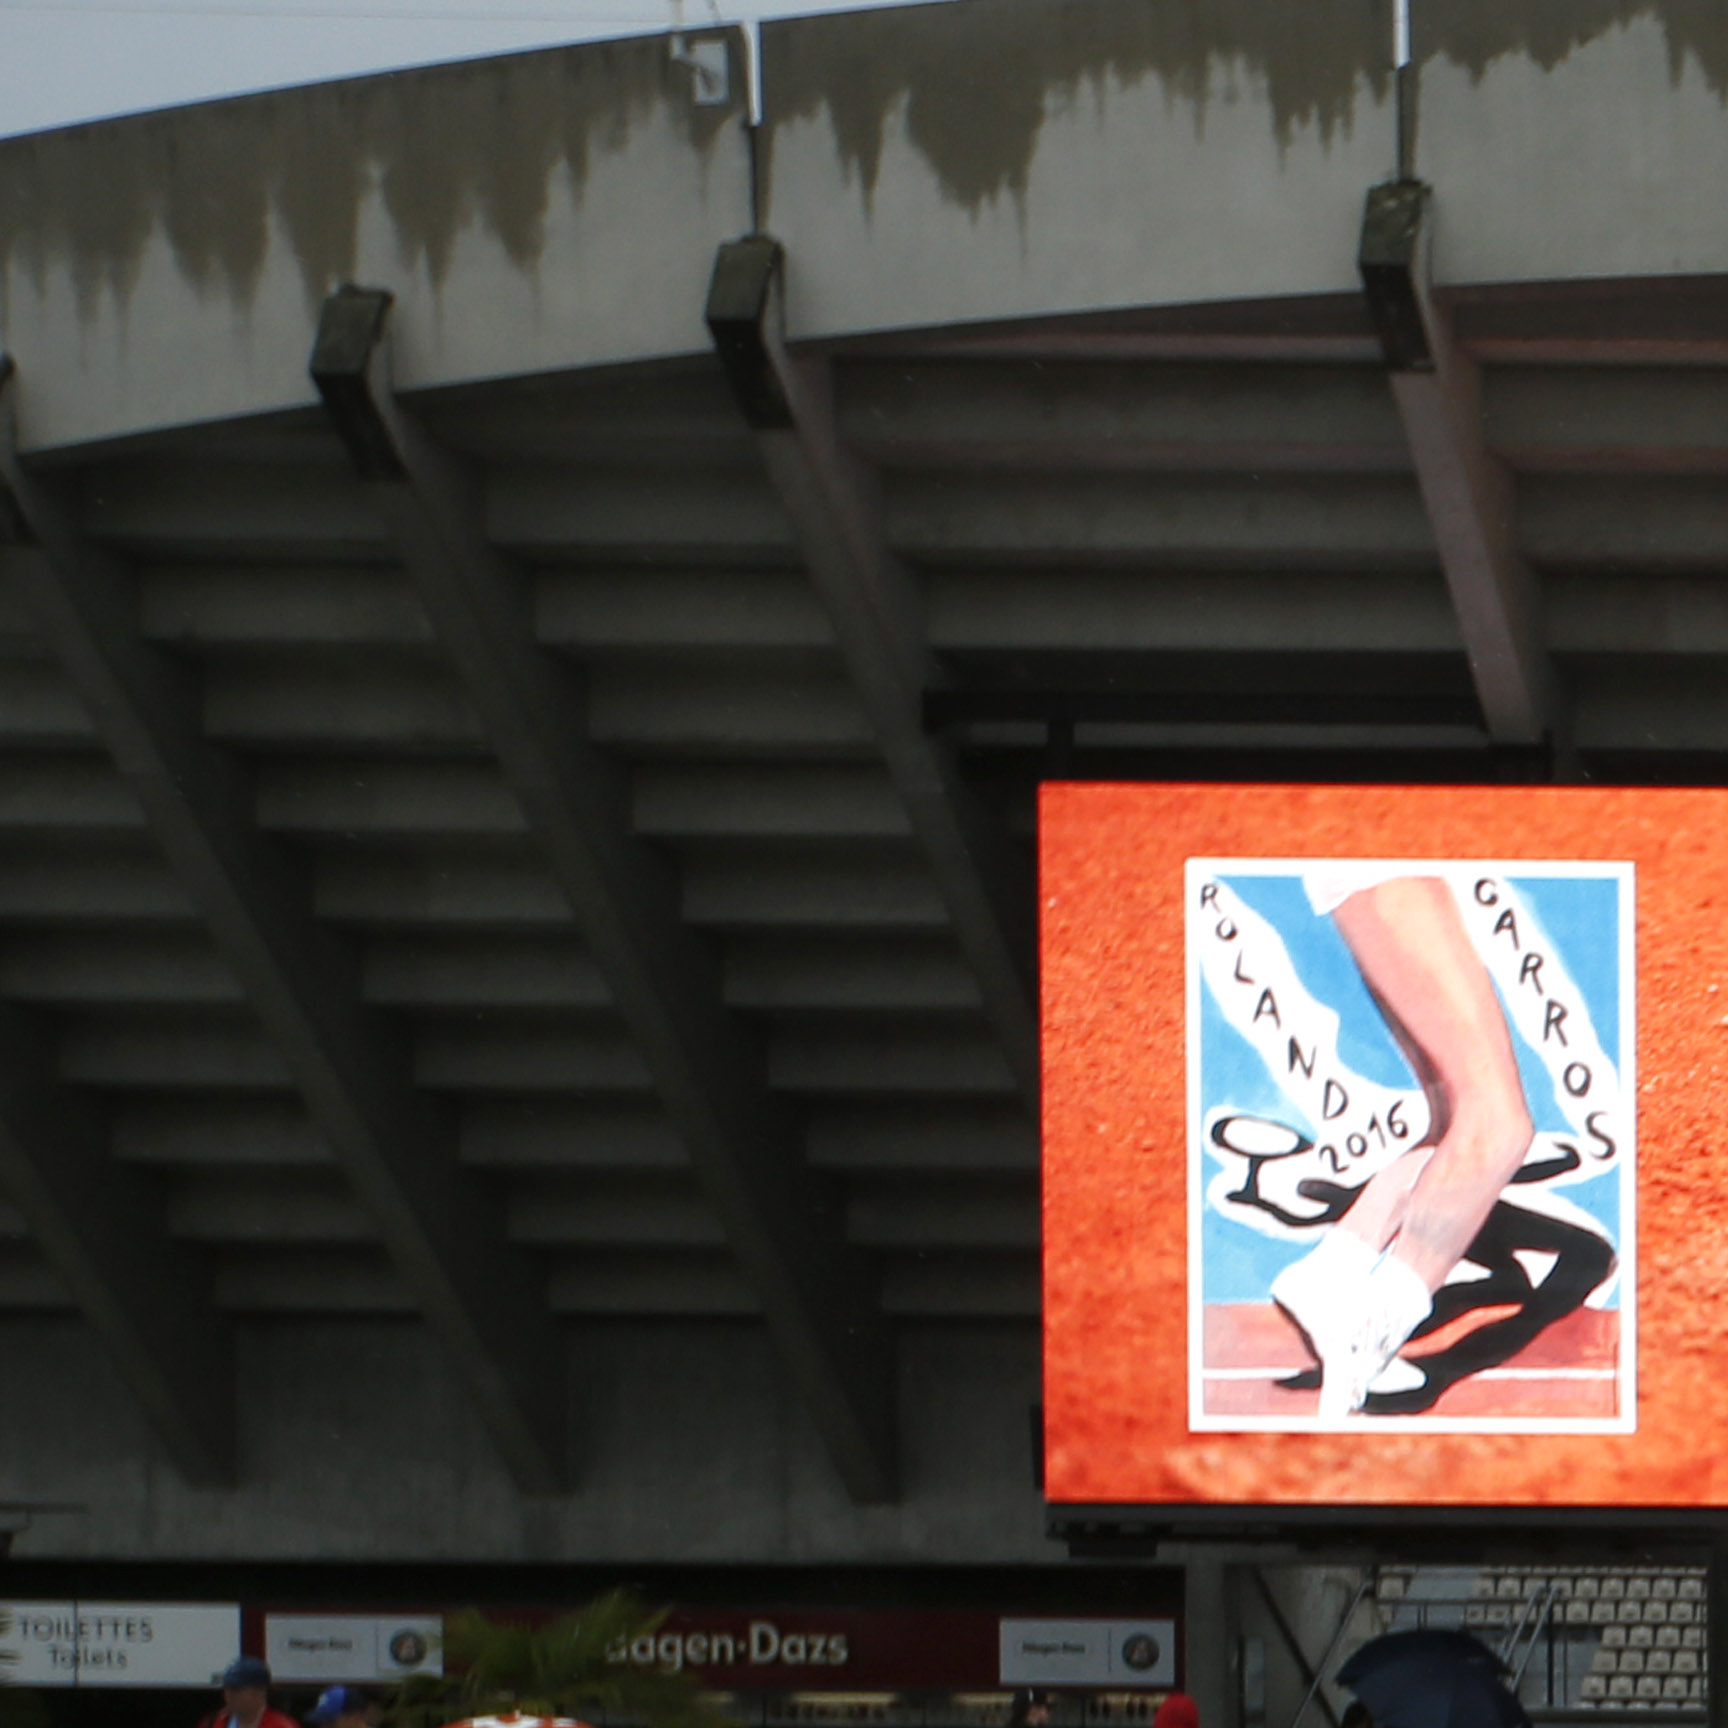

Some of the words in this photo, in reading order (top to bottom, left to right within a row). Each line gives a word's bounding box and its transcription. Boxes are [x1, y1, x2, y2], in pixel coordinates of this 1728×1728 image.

[1201, 884, 1349, 1120] ROLAND
[1474, 878, 1615, 1163] GARROS
[1318, 1100, 1409, 1174] 2016
